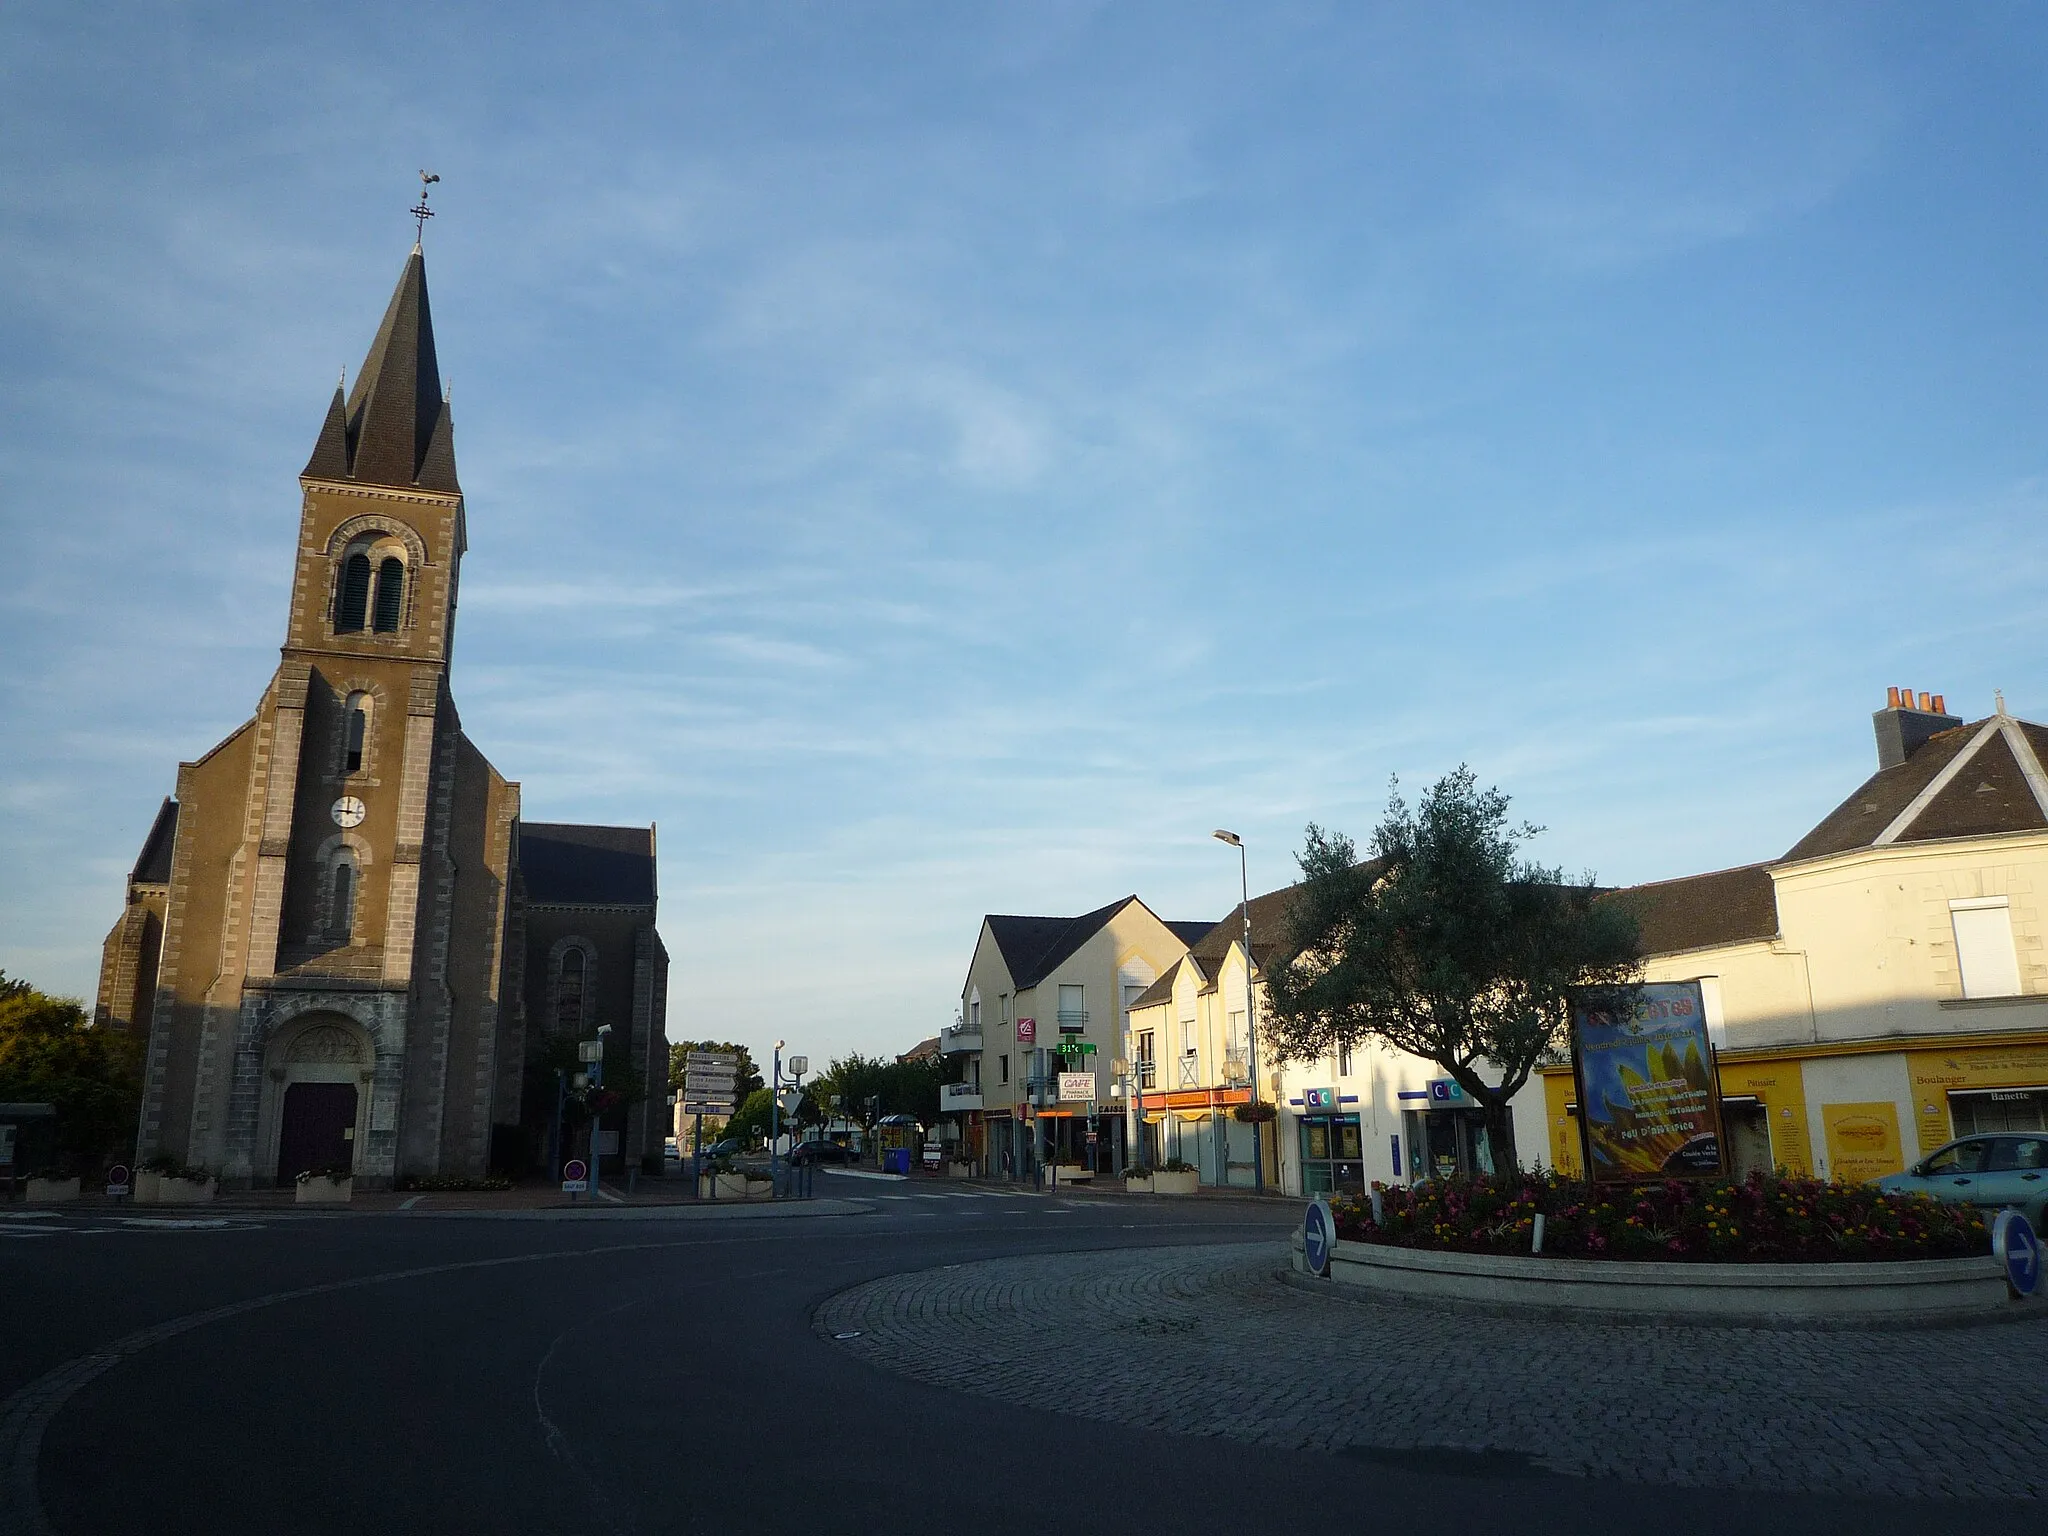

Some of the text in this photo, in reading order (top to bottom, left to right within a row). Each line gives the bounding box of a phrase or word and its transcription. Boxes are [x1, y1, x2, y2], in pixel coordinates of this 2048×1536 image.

[1916, 1075, 1967, 1086] Boulanger
[1435, 1083, 1460, 1098] CIC
[1309, 1091, 1329, 1105] CIC
[1991, 1092, 2030, 1102] Banette
